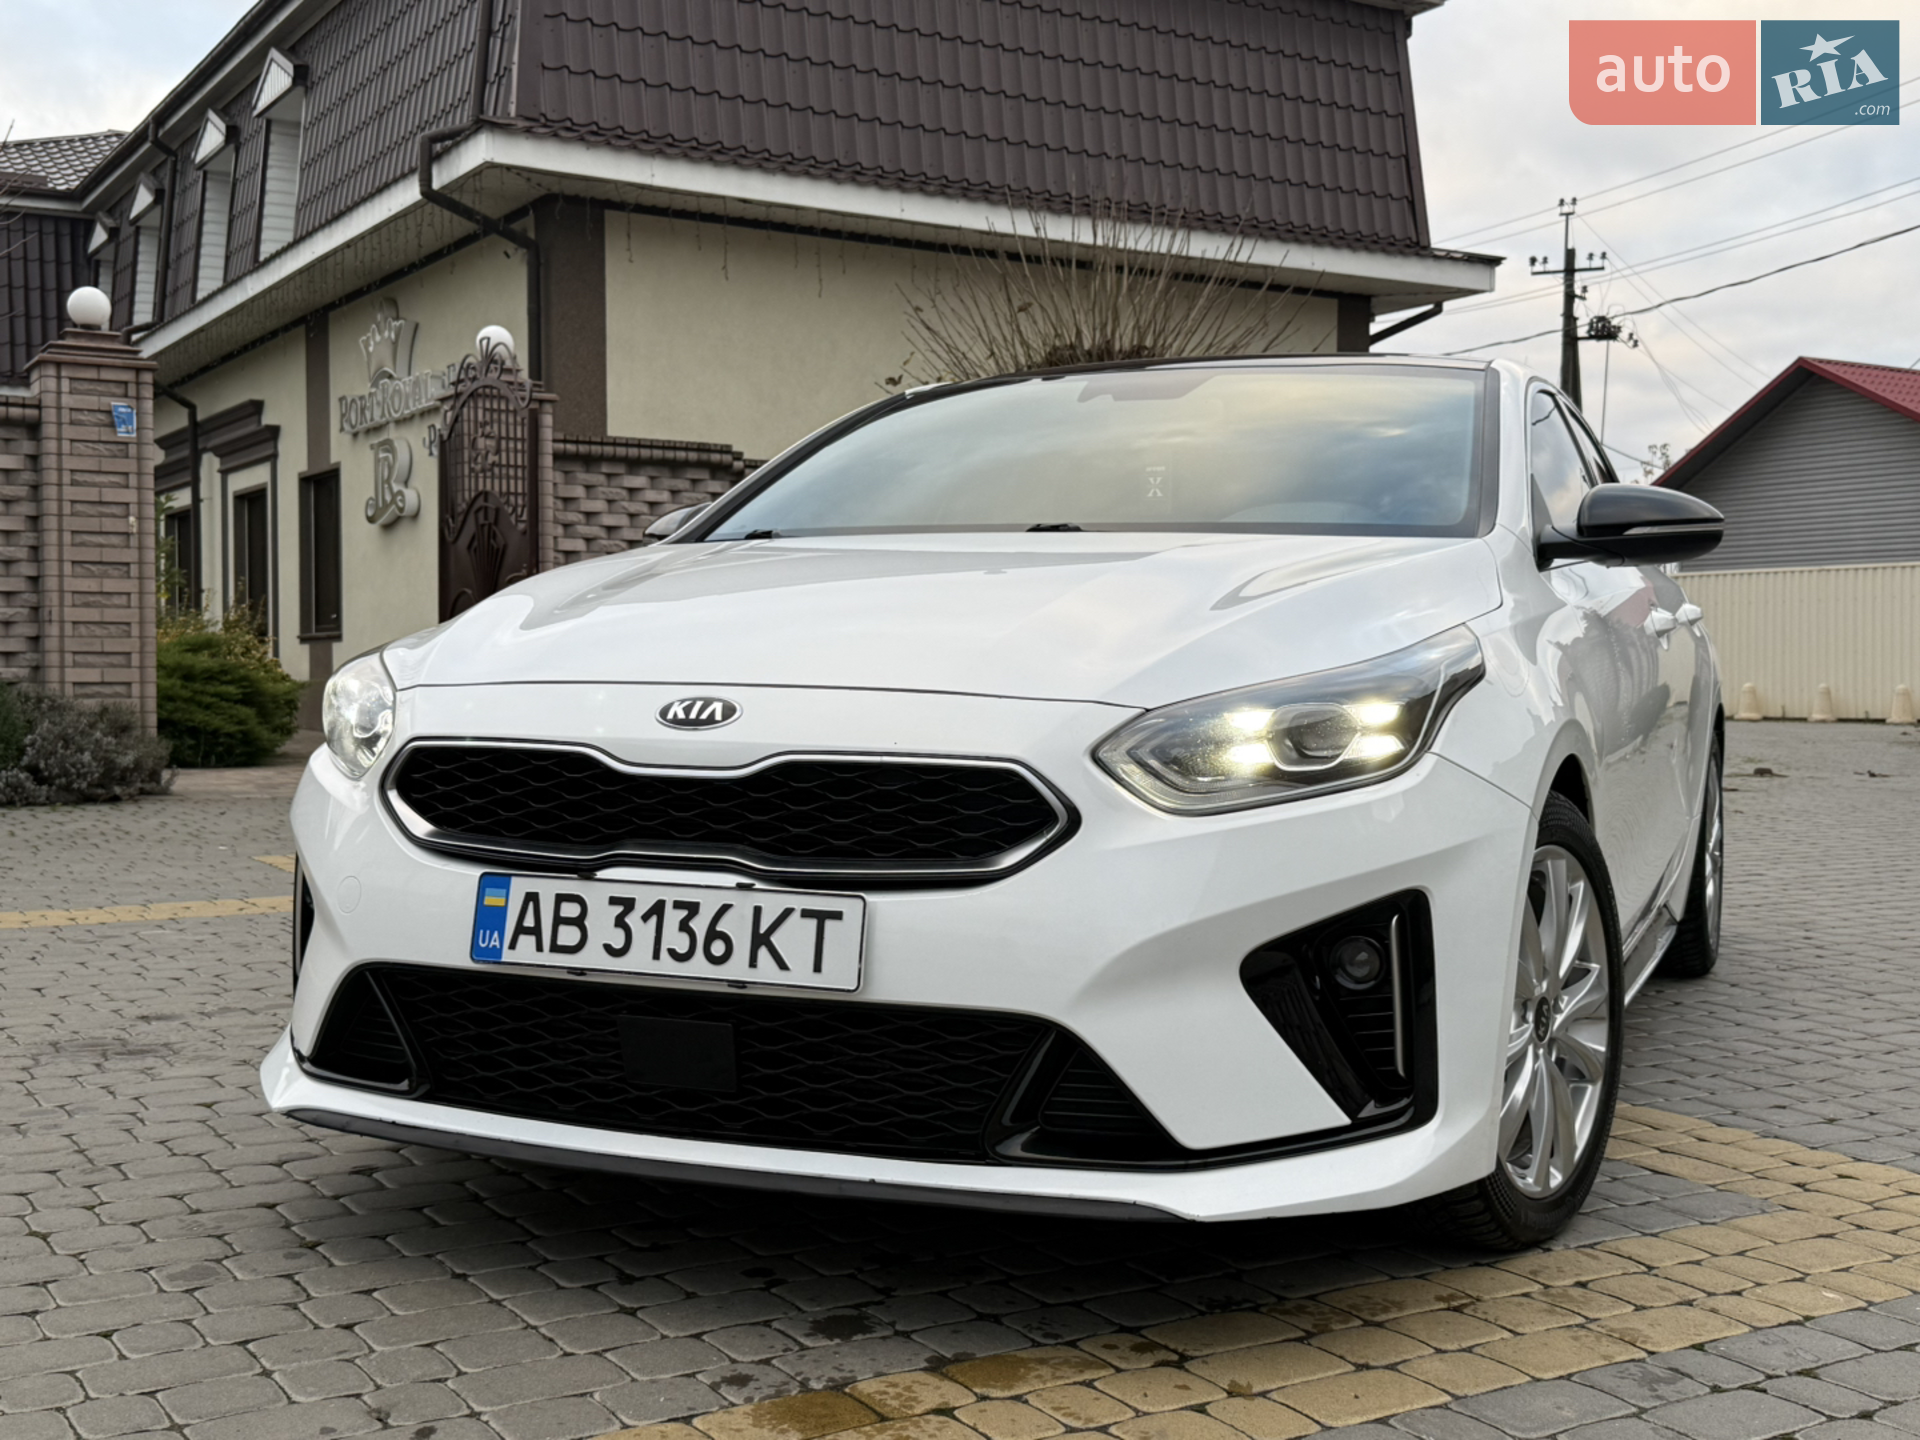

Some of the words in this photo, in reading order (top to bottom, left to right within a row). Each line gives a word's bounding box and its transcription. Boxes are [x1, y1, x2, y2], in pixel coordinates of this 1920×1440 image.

[666, 700, 724, 721] KIA
[477, 929, 500, 949] UA
[508, 891, 588, 955] AB
[602, 896, 734, 966] 3136
[748, 905, 844, 974] KT
